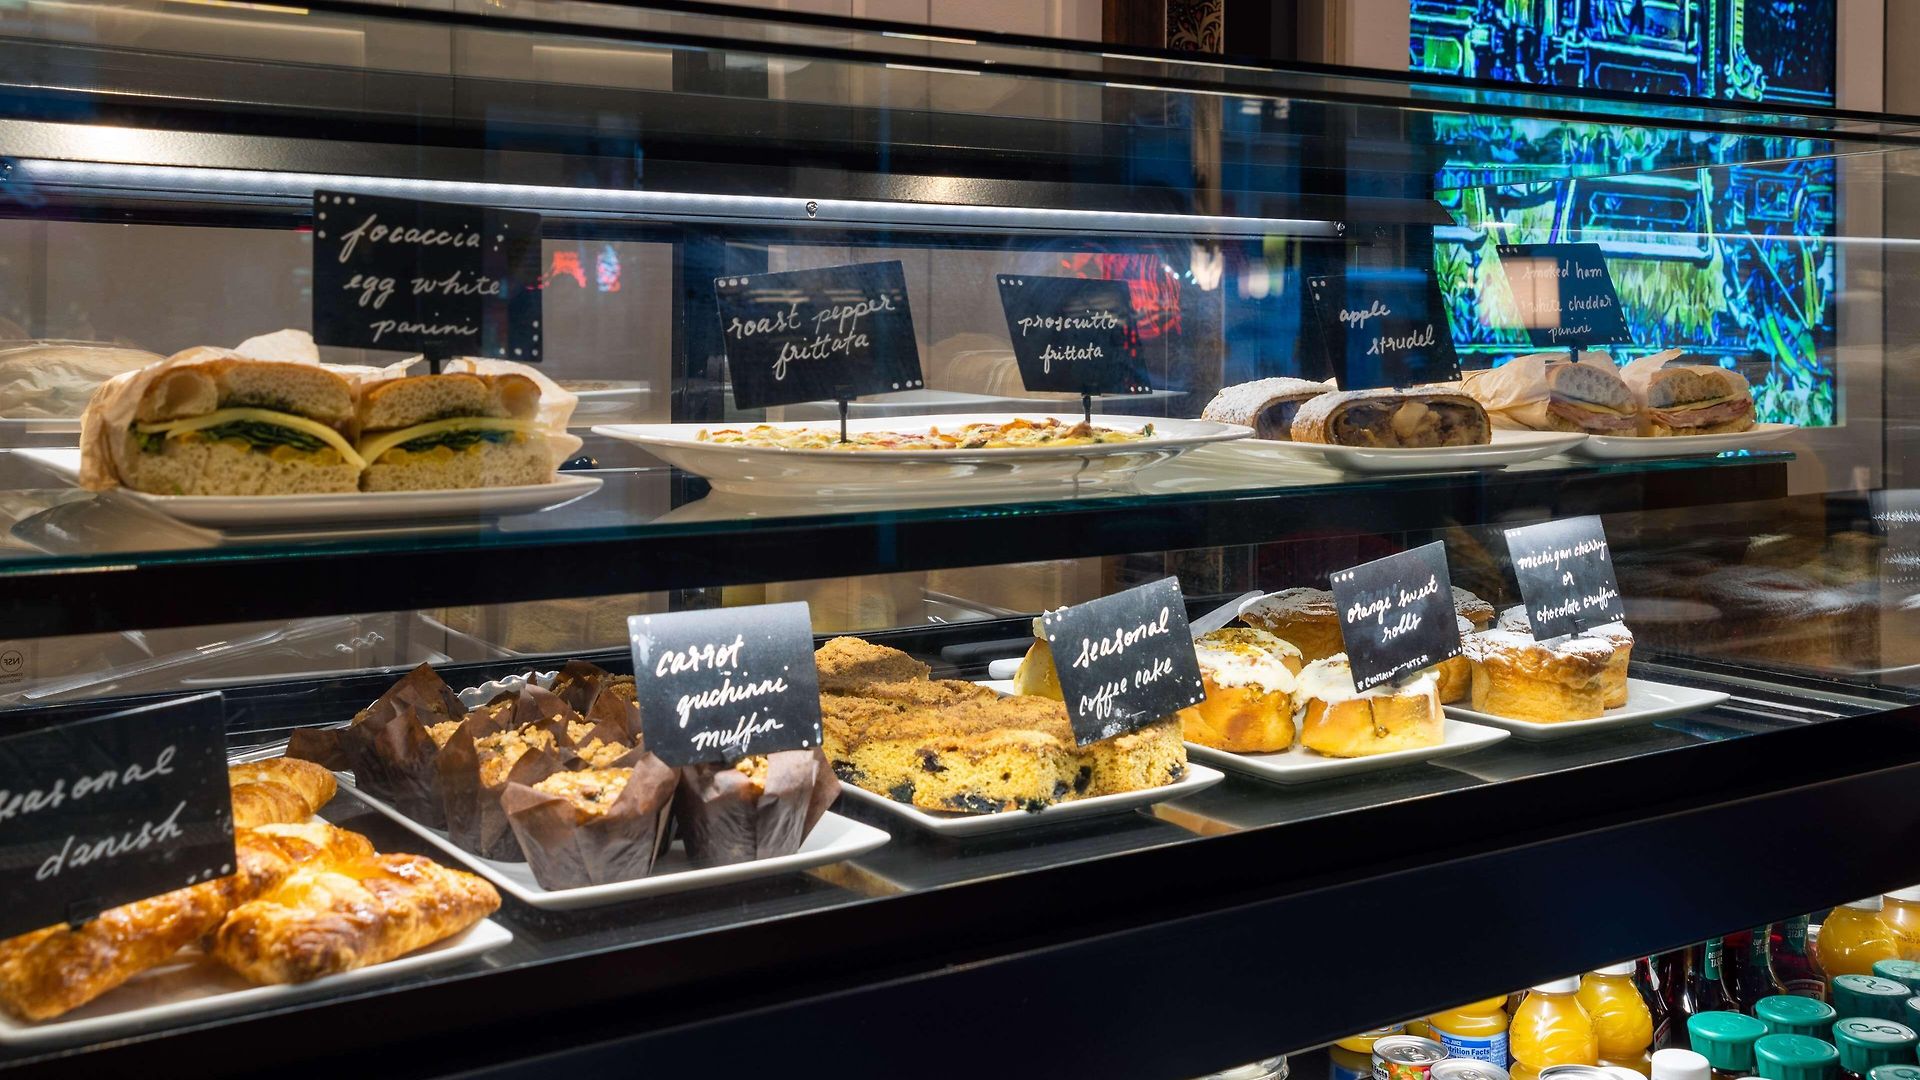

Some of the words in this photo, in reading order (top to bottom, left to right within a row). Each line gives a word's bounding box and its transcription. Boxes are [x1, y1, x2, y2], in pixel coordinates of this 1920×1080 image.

[338, 213, 480, 263] focaccia
[1576, 261, 1602, 279] ham
[343, 274, 396, 309] egg
[411, 270, 500, 295] white
[1568, 294, 1612, 311] cheddar
[369, 312, 478, 343] panini
[727, 303, 801, 340] roast
[811, 294, 896, 334] pepper
[1339, 300, 1391, 329] apple
[1547, 317, 1592, 343] panini
[772, 331, 870, 381] frittata
[1366, 324, 1435, 356] strudel
[1039, 342, 1104, 375] frittata
[1517, 546, 1572, 571] michigan
[1574, 539, 1608, 562] cherry
[1562, 571, 1575, 586] or
[1347, 596, 1392, 625] orange
[1397, 574, 1438, 608] sweet
[1536, 598, 1581, 624] chocolate
[1583, 580, 1618, 611] cruffin
[1072, 606, 1170, 668] seasonal
[1381, 612, 1422, 643] rolls
[655, 634, 745, 677] carrot
[1079, 678, 1128, 721] coffee
[1134, 657, 1173, 689] cake
[691, 706, 784, 753] muffin
[35, 800, 187, 881] danish
[1471, 1048, 1490, 1056] Facts
